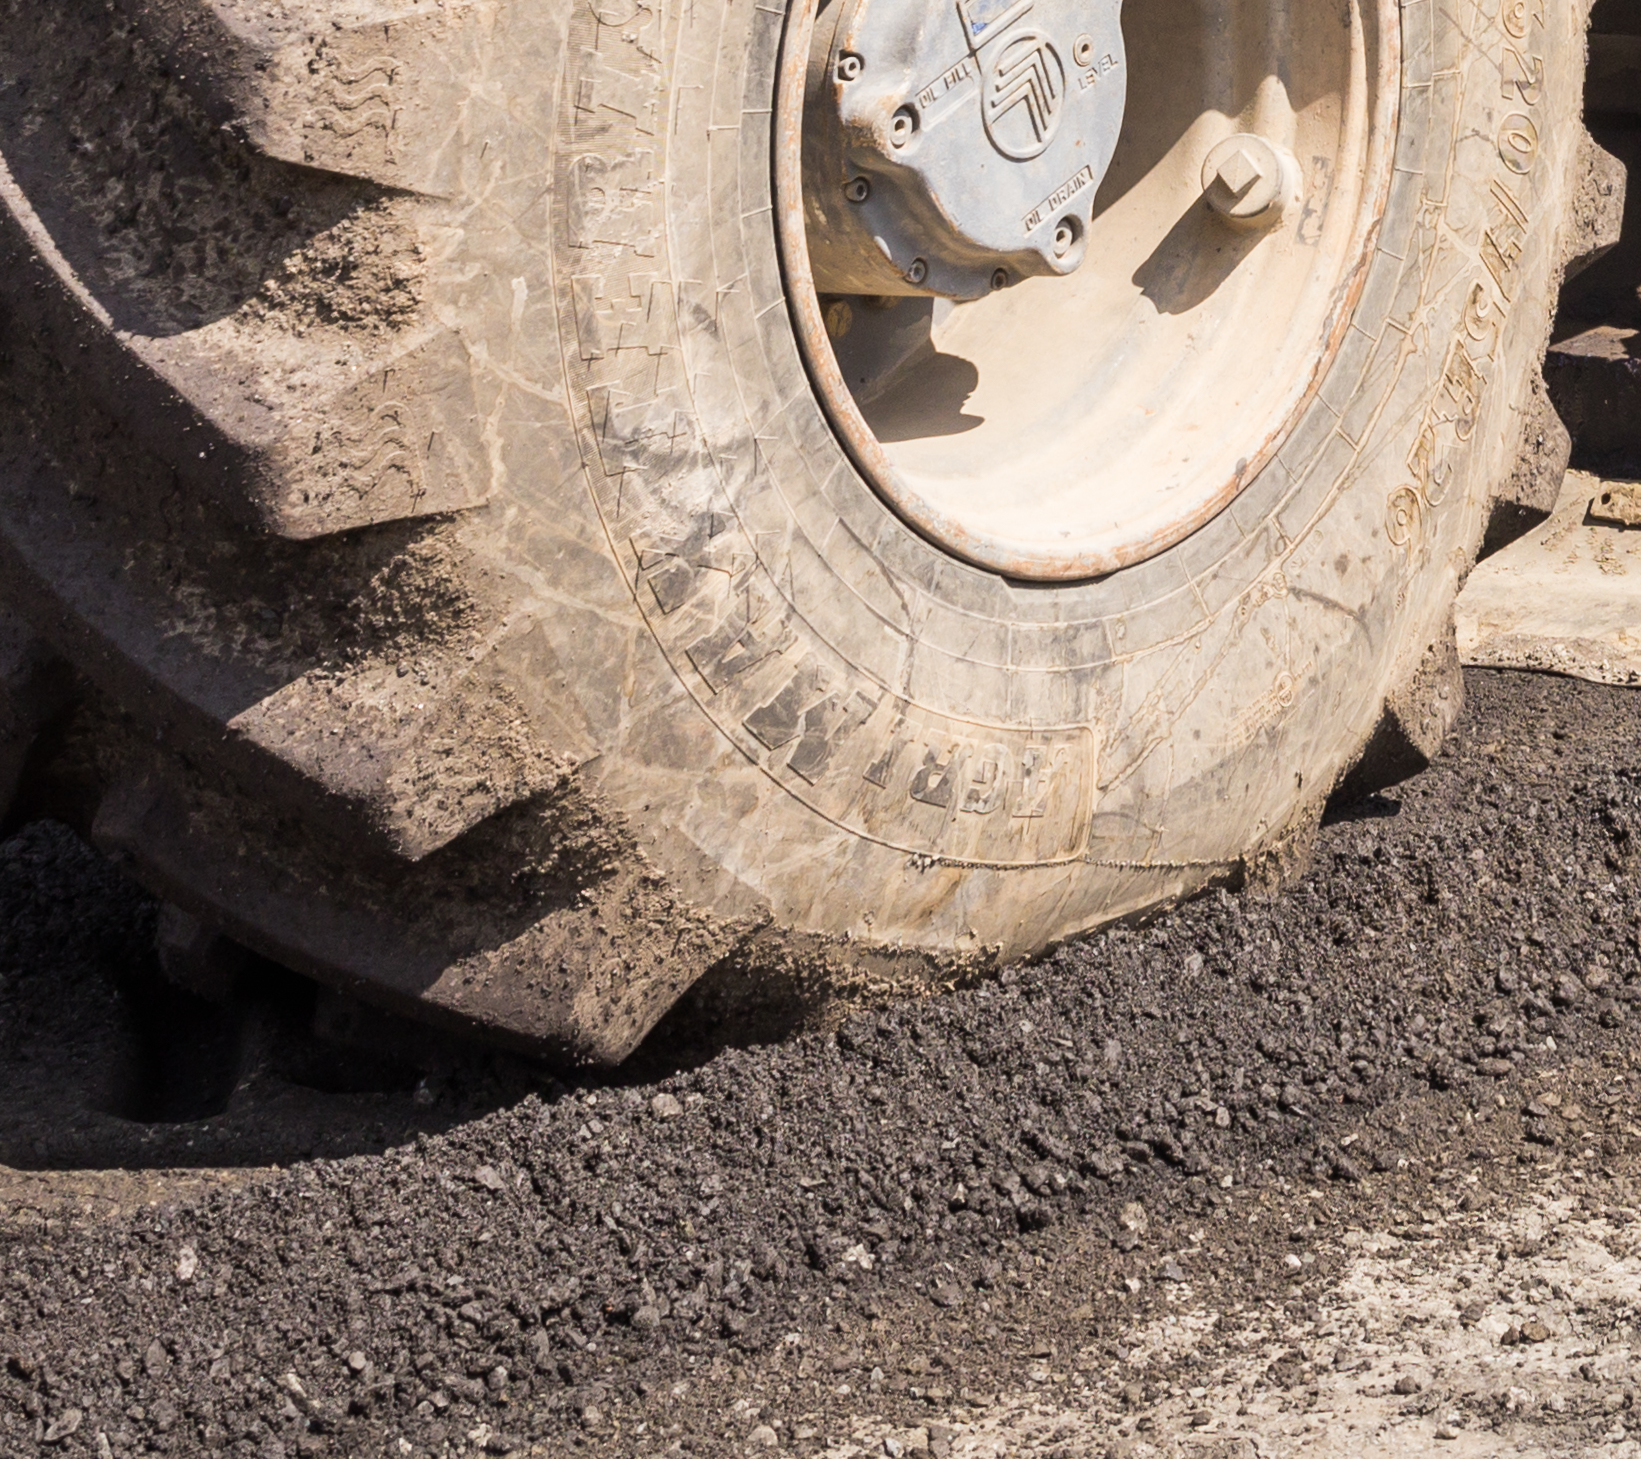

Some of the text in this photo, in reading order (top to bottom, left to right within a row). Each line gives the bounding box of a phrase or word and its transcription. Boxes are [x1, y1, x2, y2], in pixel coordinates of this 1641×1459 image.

[919, 63, 972, 109] OIL FILL
[1077, 54, 1119, 91] LEVEL
[1025, 171, 1088, 232] OIL DRAIN
